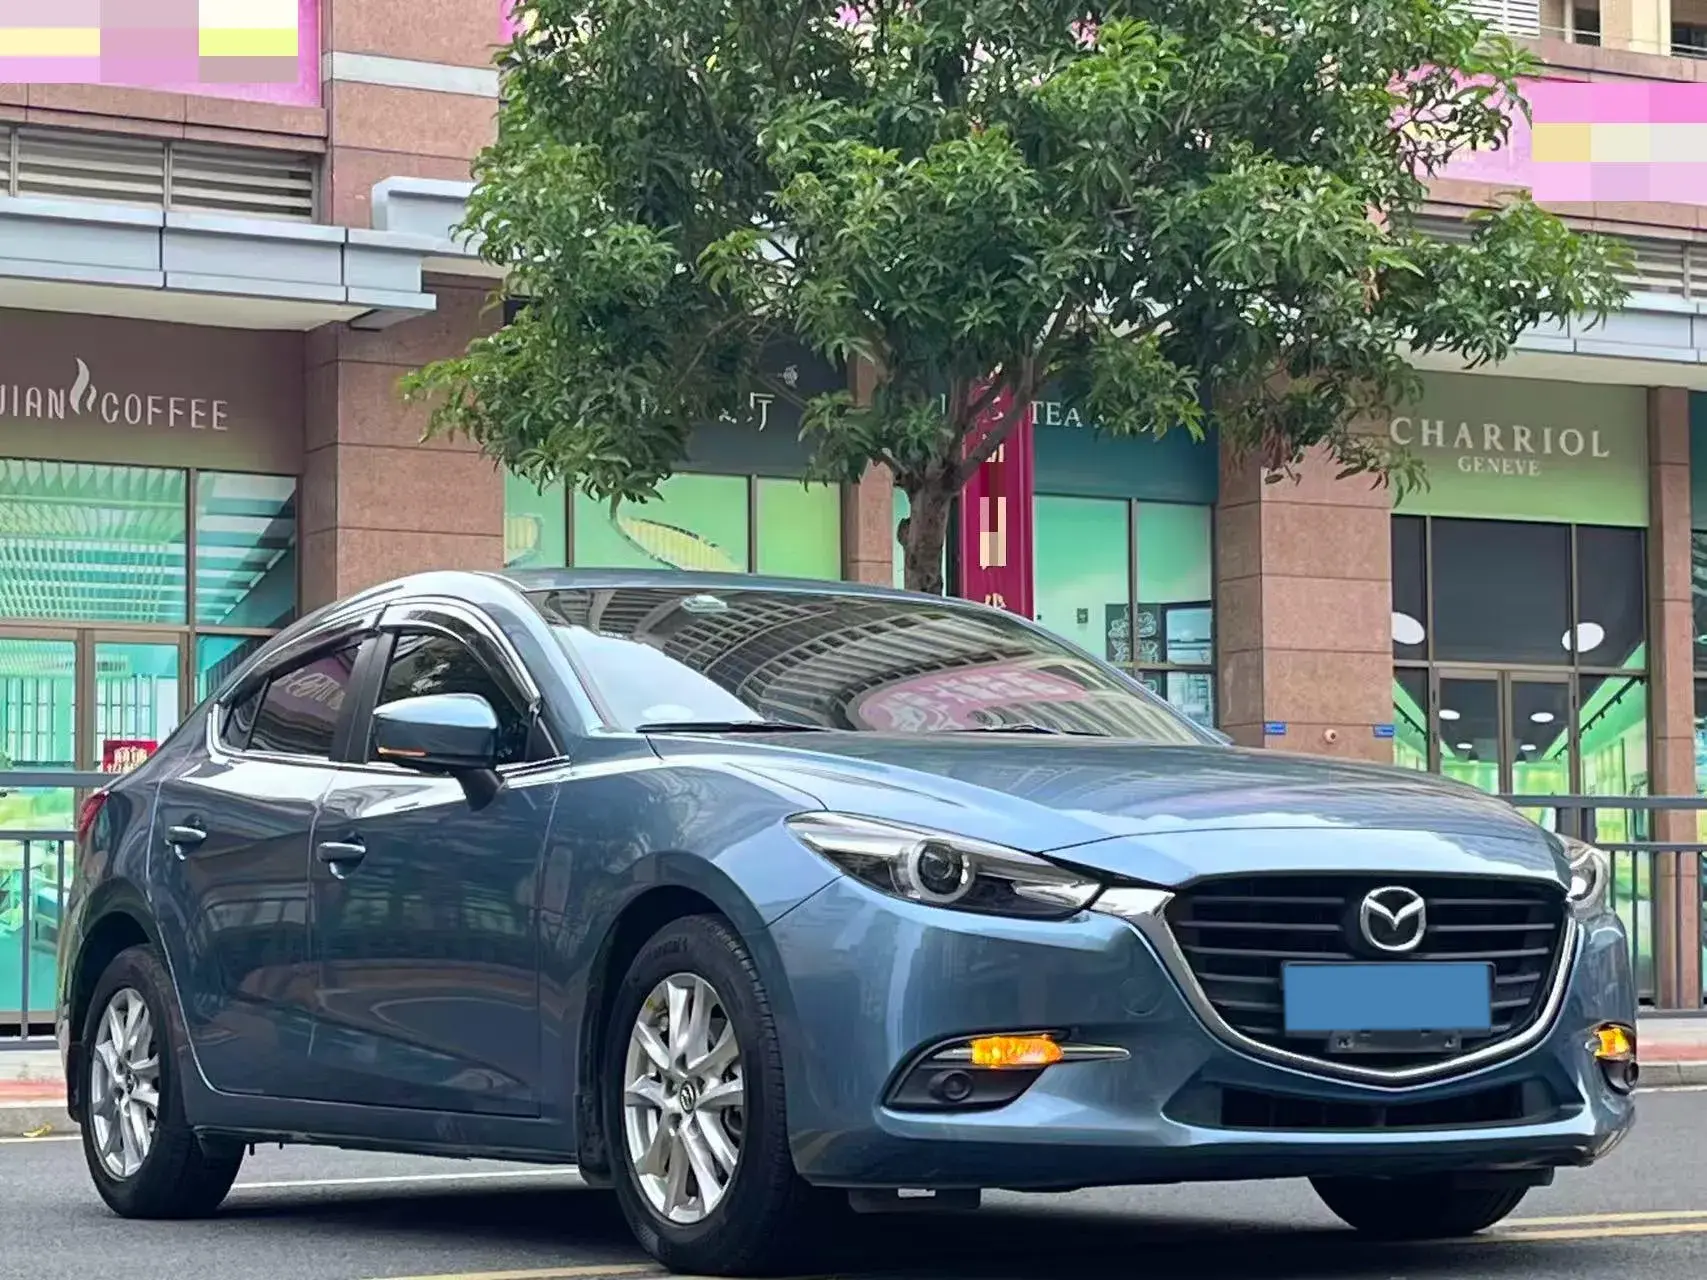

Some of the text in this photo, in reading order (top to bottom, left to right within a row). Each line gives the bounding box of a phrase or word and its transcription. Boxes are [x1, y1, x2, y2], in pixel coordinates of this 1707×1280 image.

[101, 391, 229, 430] COFFEE
[1031, 400, 1083, 428] TEA
[1389, 416, 1610, 458] CHARRIOL
[1457, 455, 1542, 477] GENEVE
